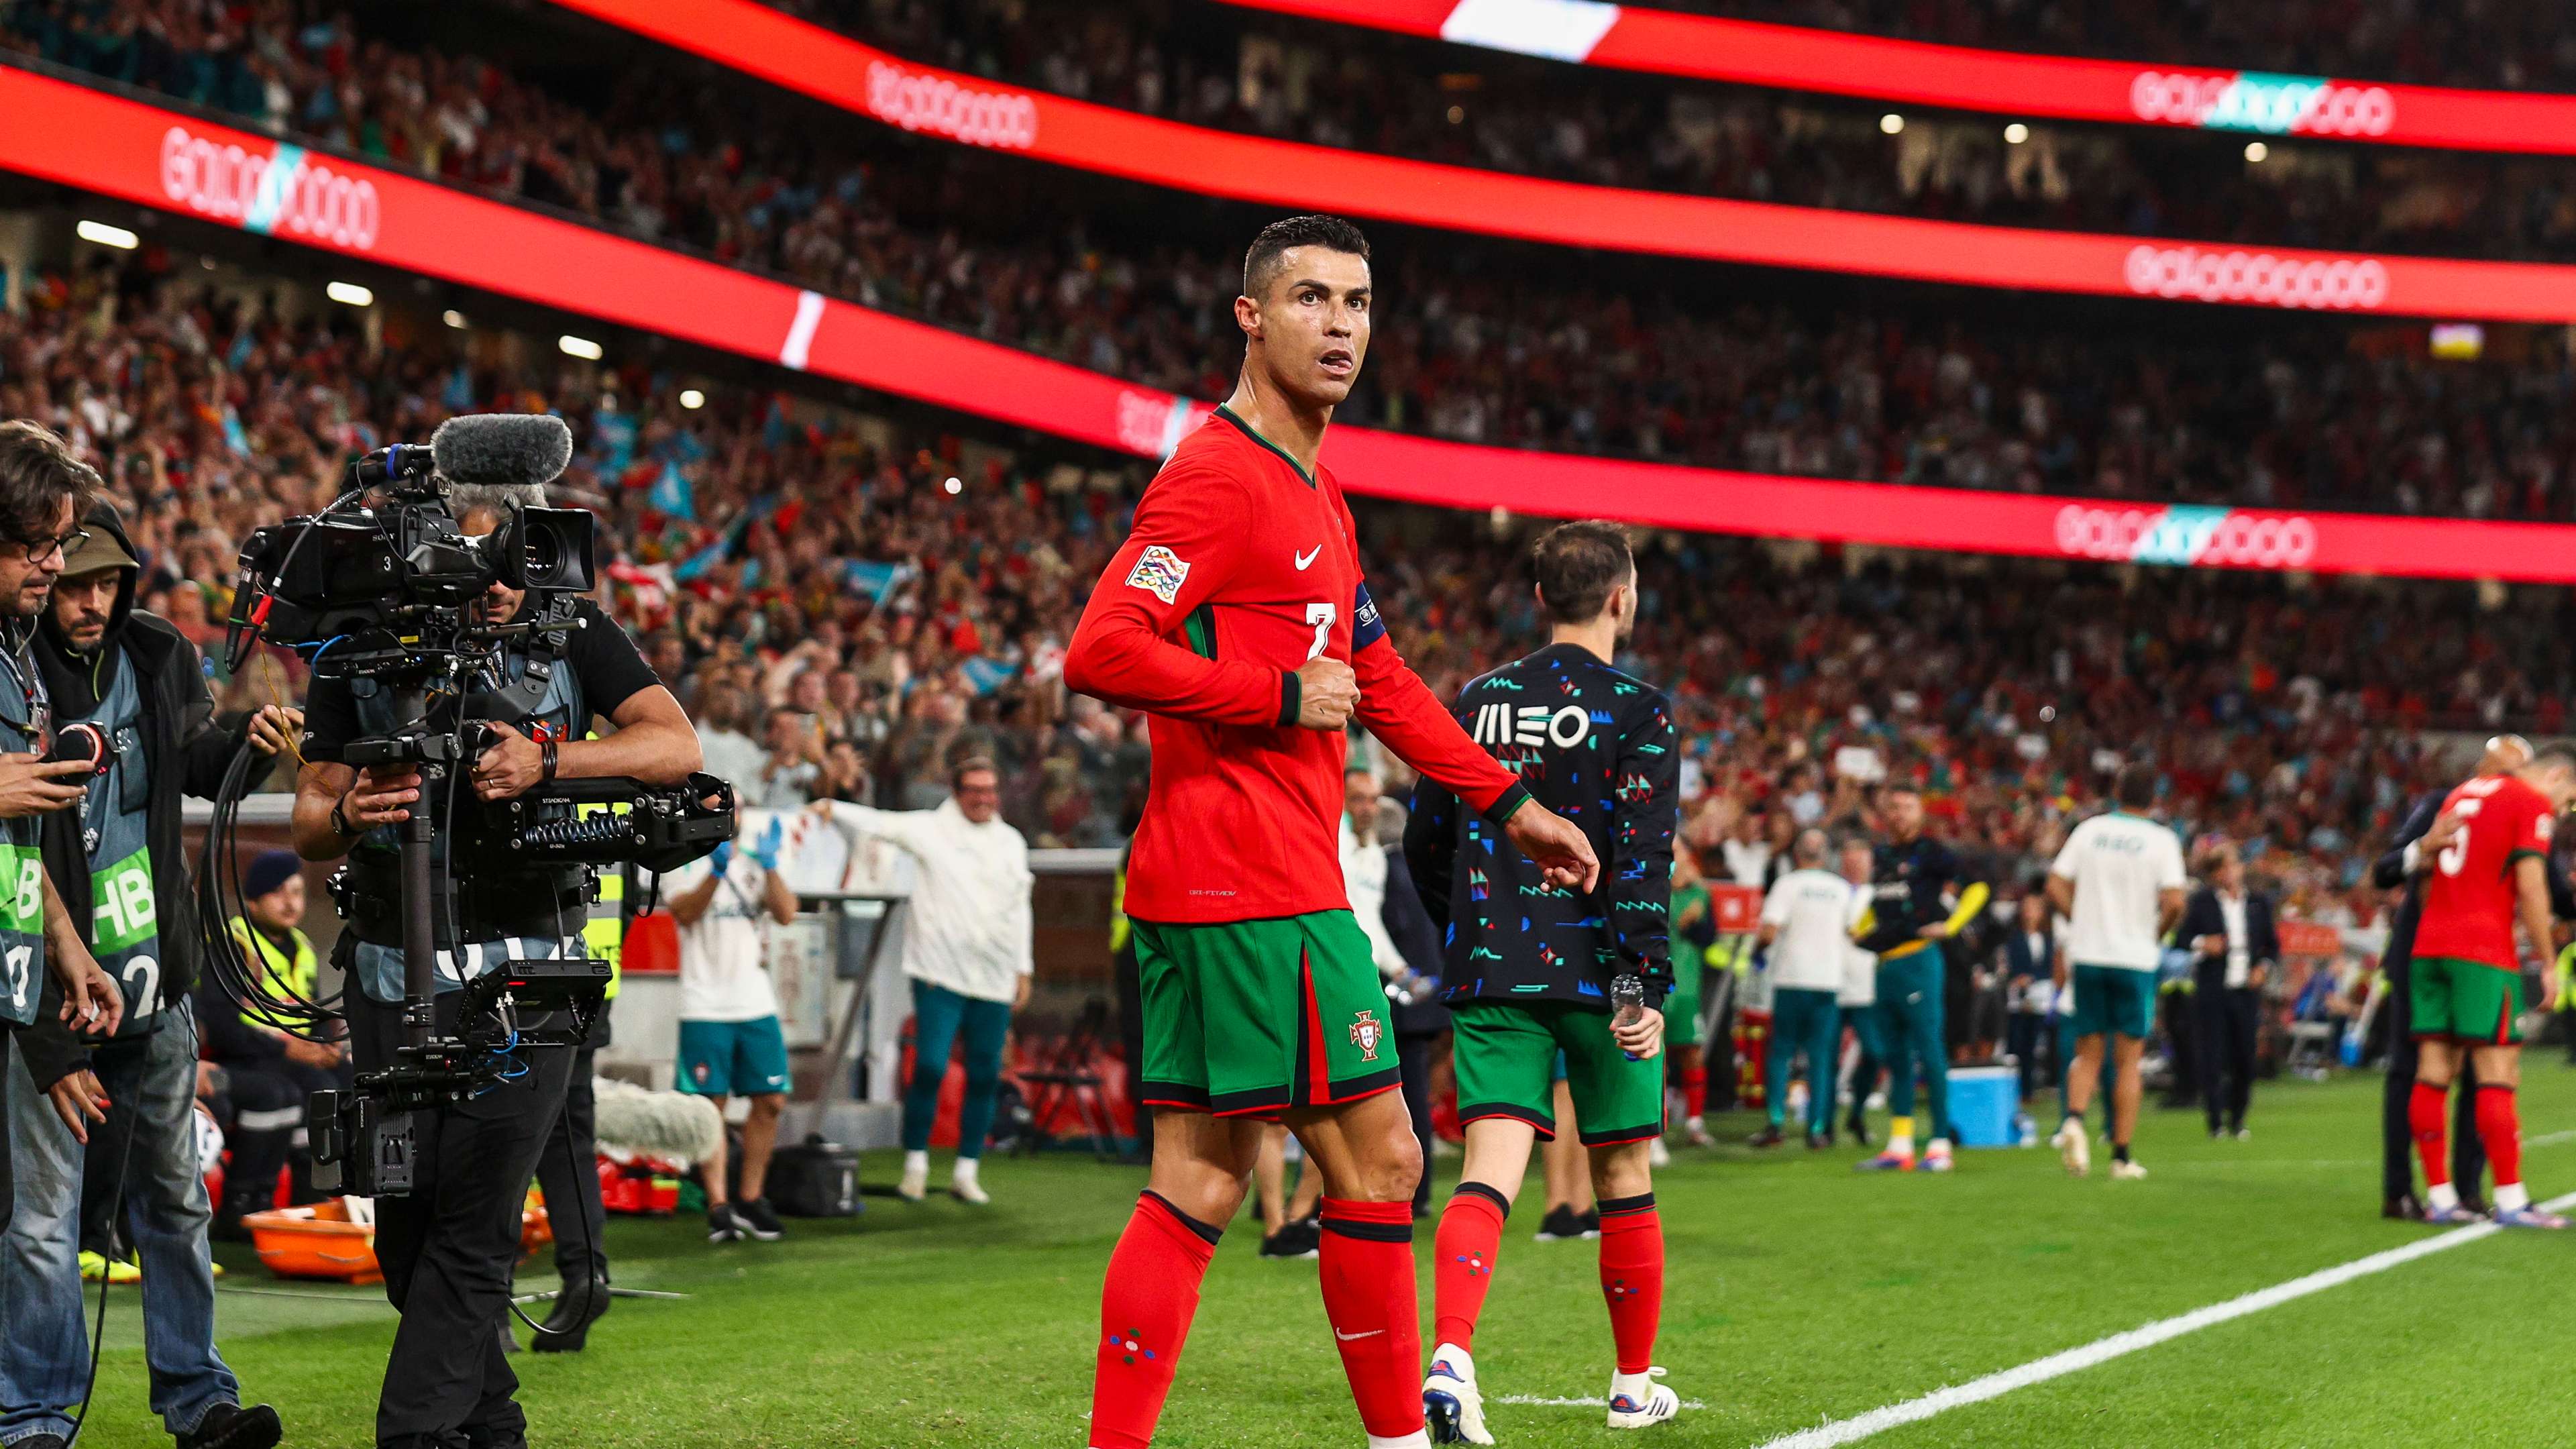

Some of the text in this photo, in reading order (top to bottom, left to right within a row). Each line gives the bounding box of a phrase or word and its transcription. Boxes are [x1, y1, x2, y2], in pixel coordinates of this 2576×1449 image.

[383, 555, 392, 572] 3
[1306, 602, 1336, 661] 7
[1473, 702, 1591, 748] MEO
[2438, 798, 2483, 877] 5
[15, 857, 42, 920] B
[92, 868, 156, 945] HB
[107, 955, 166, 1019] 2
